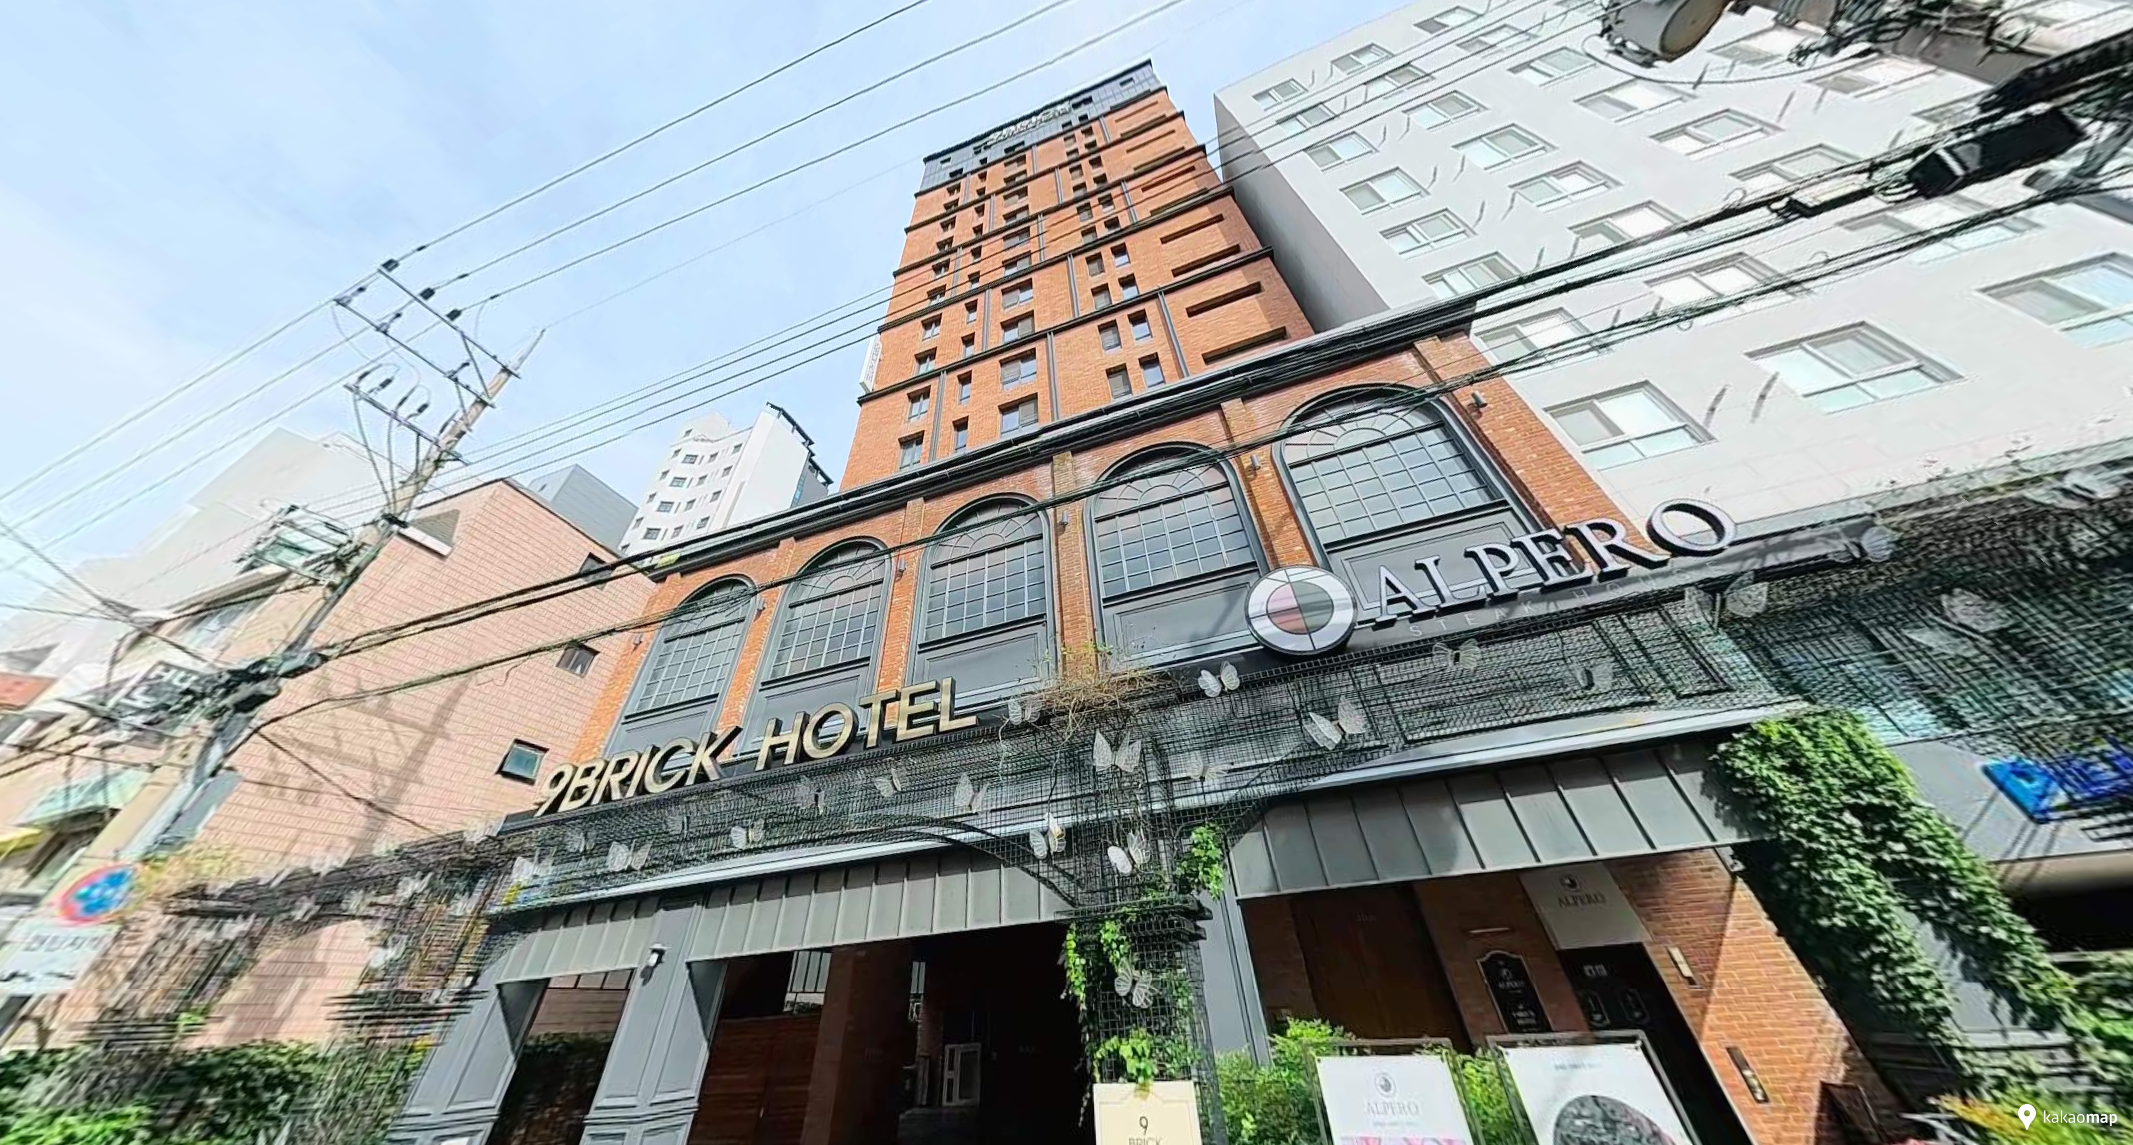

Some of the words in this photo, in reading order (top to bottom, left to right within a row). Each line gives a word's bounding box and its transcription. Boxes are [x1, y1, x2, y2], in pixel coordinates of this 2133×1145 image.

[1372, 498, 1738, 630] ALPERO
[1409, 601, 1536, 637] STEAK
[533, 726, 743, 818] 9BRICK
[755, 676, 978, 772] HOTEL
[1138, 1115, 1149, 1136] 9
[1366, 1100, 1420, 1118] ALPERO
